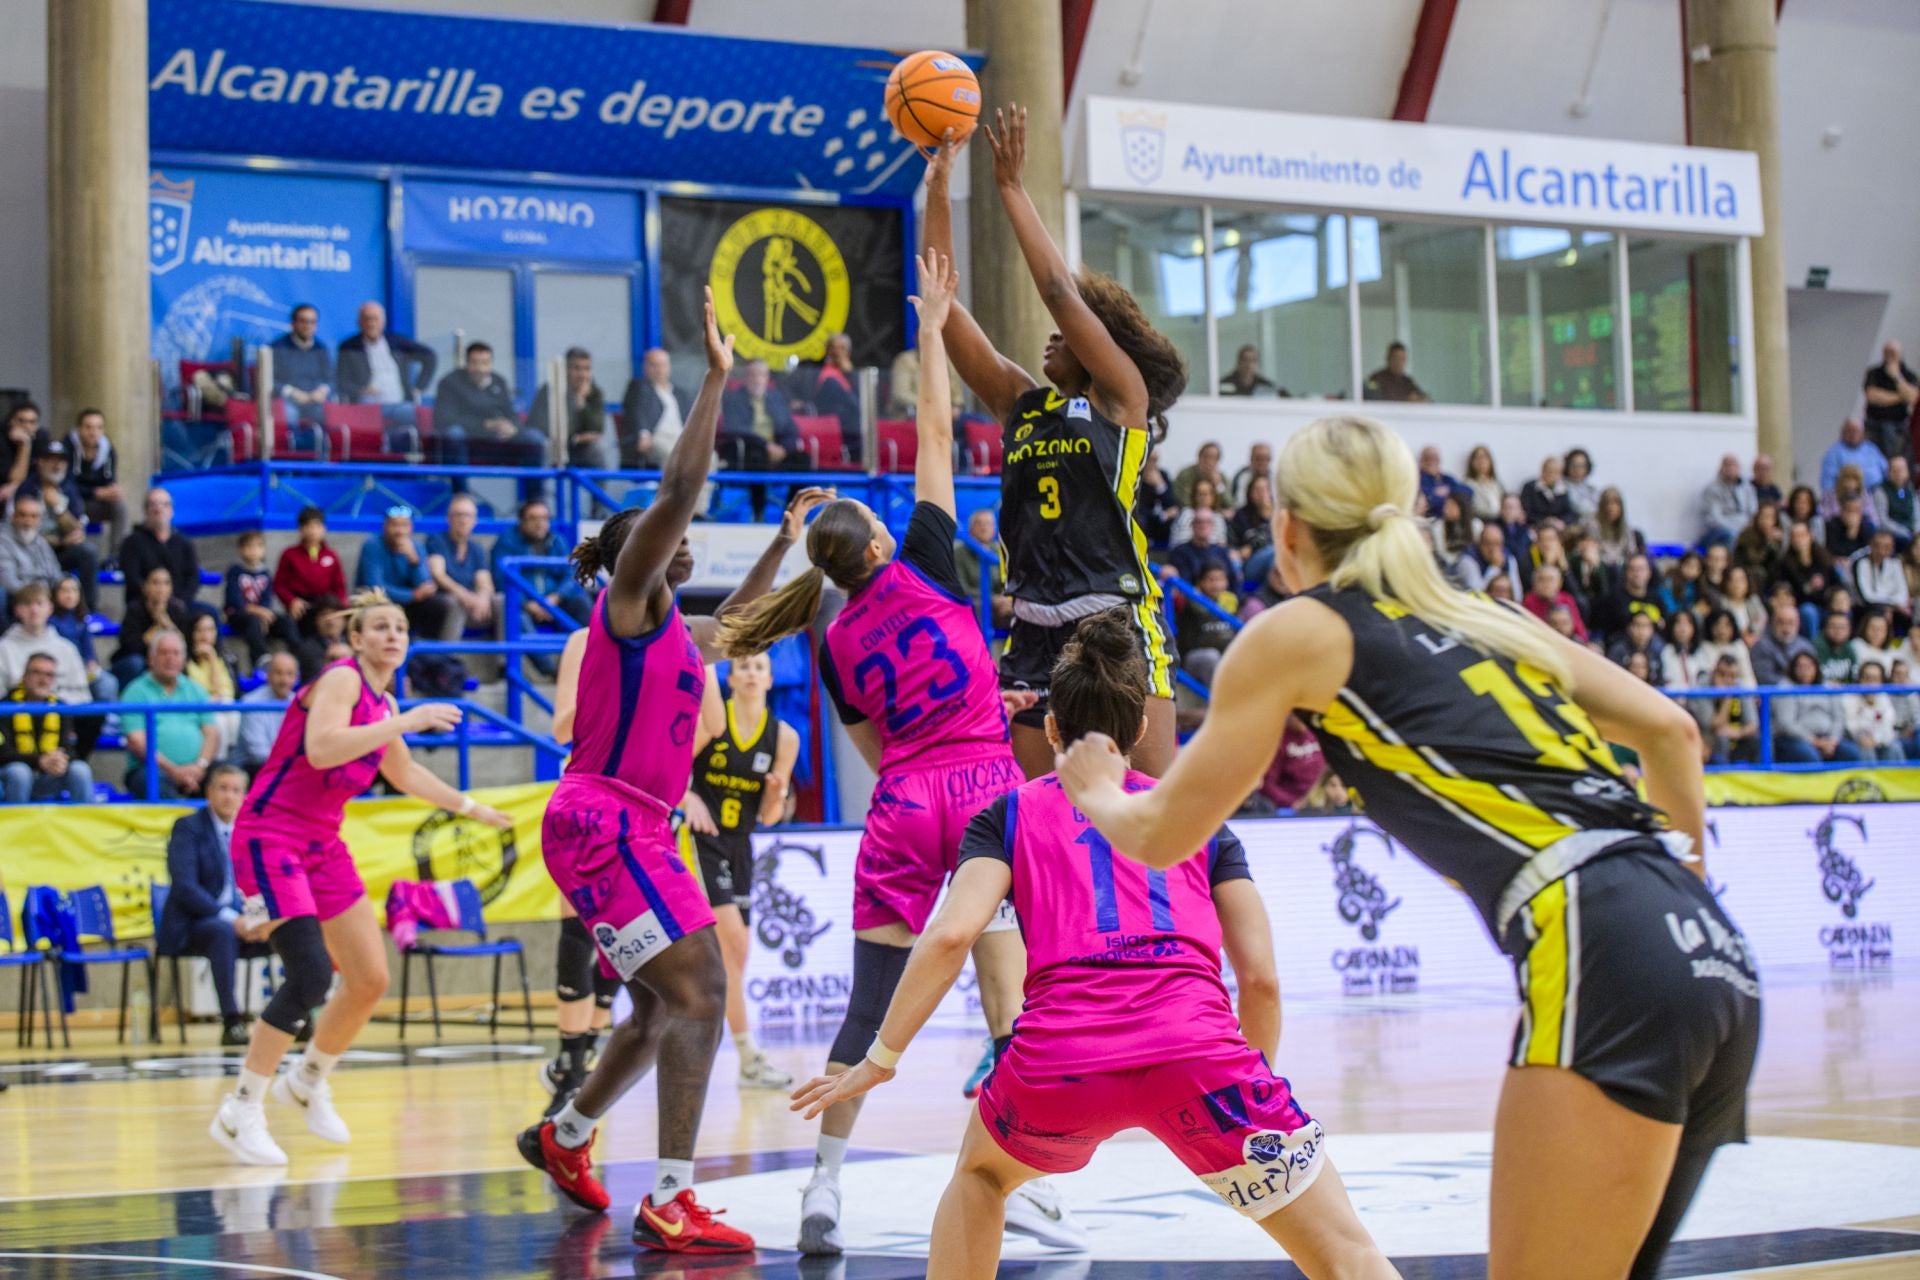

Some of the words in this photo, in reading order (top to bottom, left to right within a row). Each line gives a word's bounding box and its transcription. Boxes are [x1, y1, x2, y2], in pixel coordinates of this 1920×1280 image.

[149, 48, 504, 117] Alcantarilla
[520, 86, 586, 121] es
[600, 79, 825, 140] deporte
[1183, 143, 1380, 188] Ayuntamiento
[1388, 160, 1422, 190] de
[1462, 147, 1738, 219] Alcantarilla
[227, 218, 328, 239] Ayuntamiento
[330, 224, 350, 241] de
[449, 196, 595, 228] HOZONO
[192, 236, 352, 272] Alcantarilla
[1008, 438, 1091, 464] HOZONO
[1038, 476, 1062, 519] 3
[860, 608, 911, 651] CONTELL
[853, 616, 970, 733] 23
[947, 758, 1018, 798] CICAR
[721, 797, 742, 828] 6
[1105, 935, 1150, 950] Islas
[1220, 1174, 1278, 1207] der
[1295, 1127, 1324, 1171] sas
